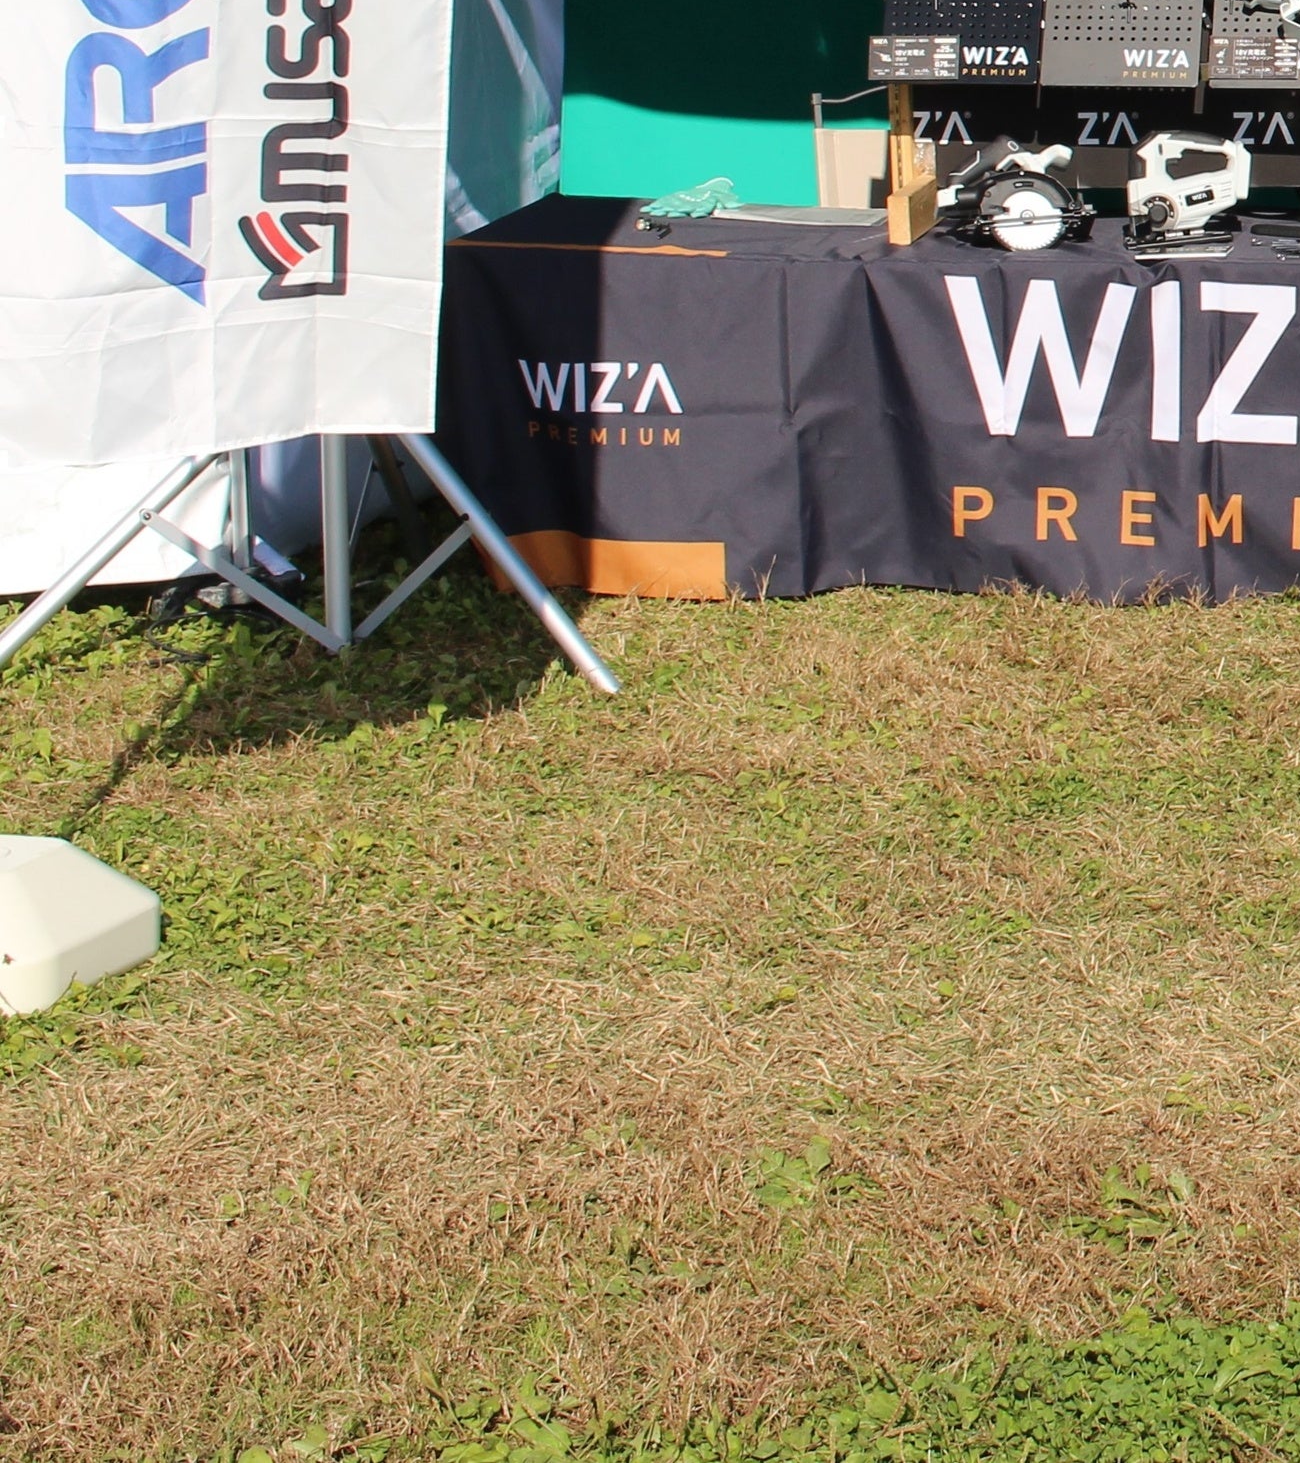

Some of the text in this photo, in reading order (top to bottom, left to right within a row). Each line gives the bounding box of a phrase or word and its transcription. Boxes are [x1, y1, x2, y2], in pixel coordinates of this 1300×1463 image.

[962, 46, 1029, 66] WIZ'A
[1123, 49, 1189, 68] WIZ'A
[962, 68, 1027, 76] PREMIUM
[1123, 70, 1188, 79] PREMIUM
[517, 358, 684, 416] WIZ'A
[527, 419, 682, 447] PREMIUM
